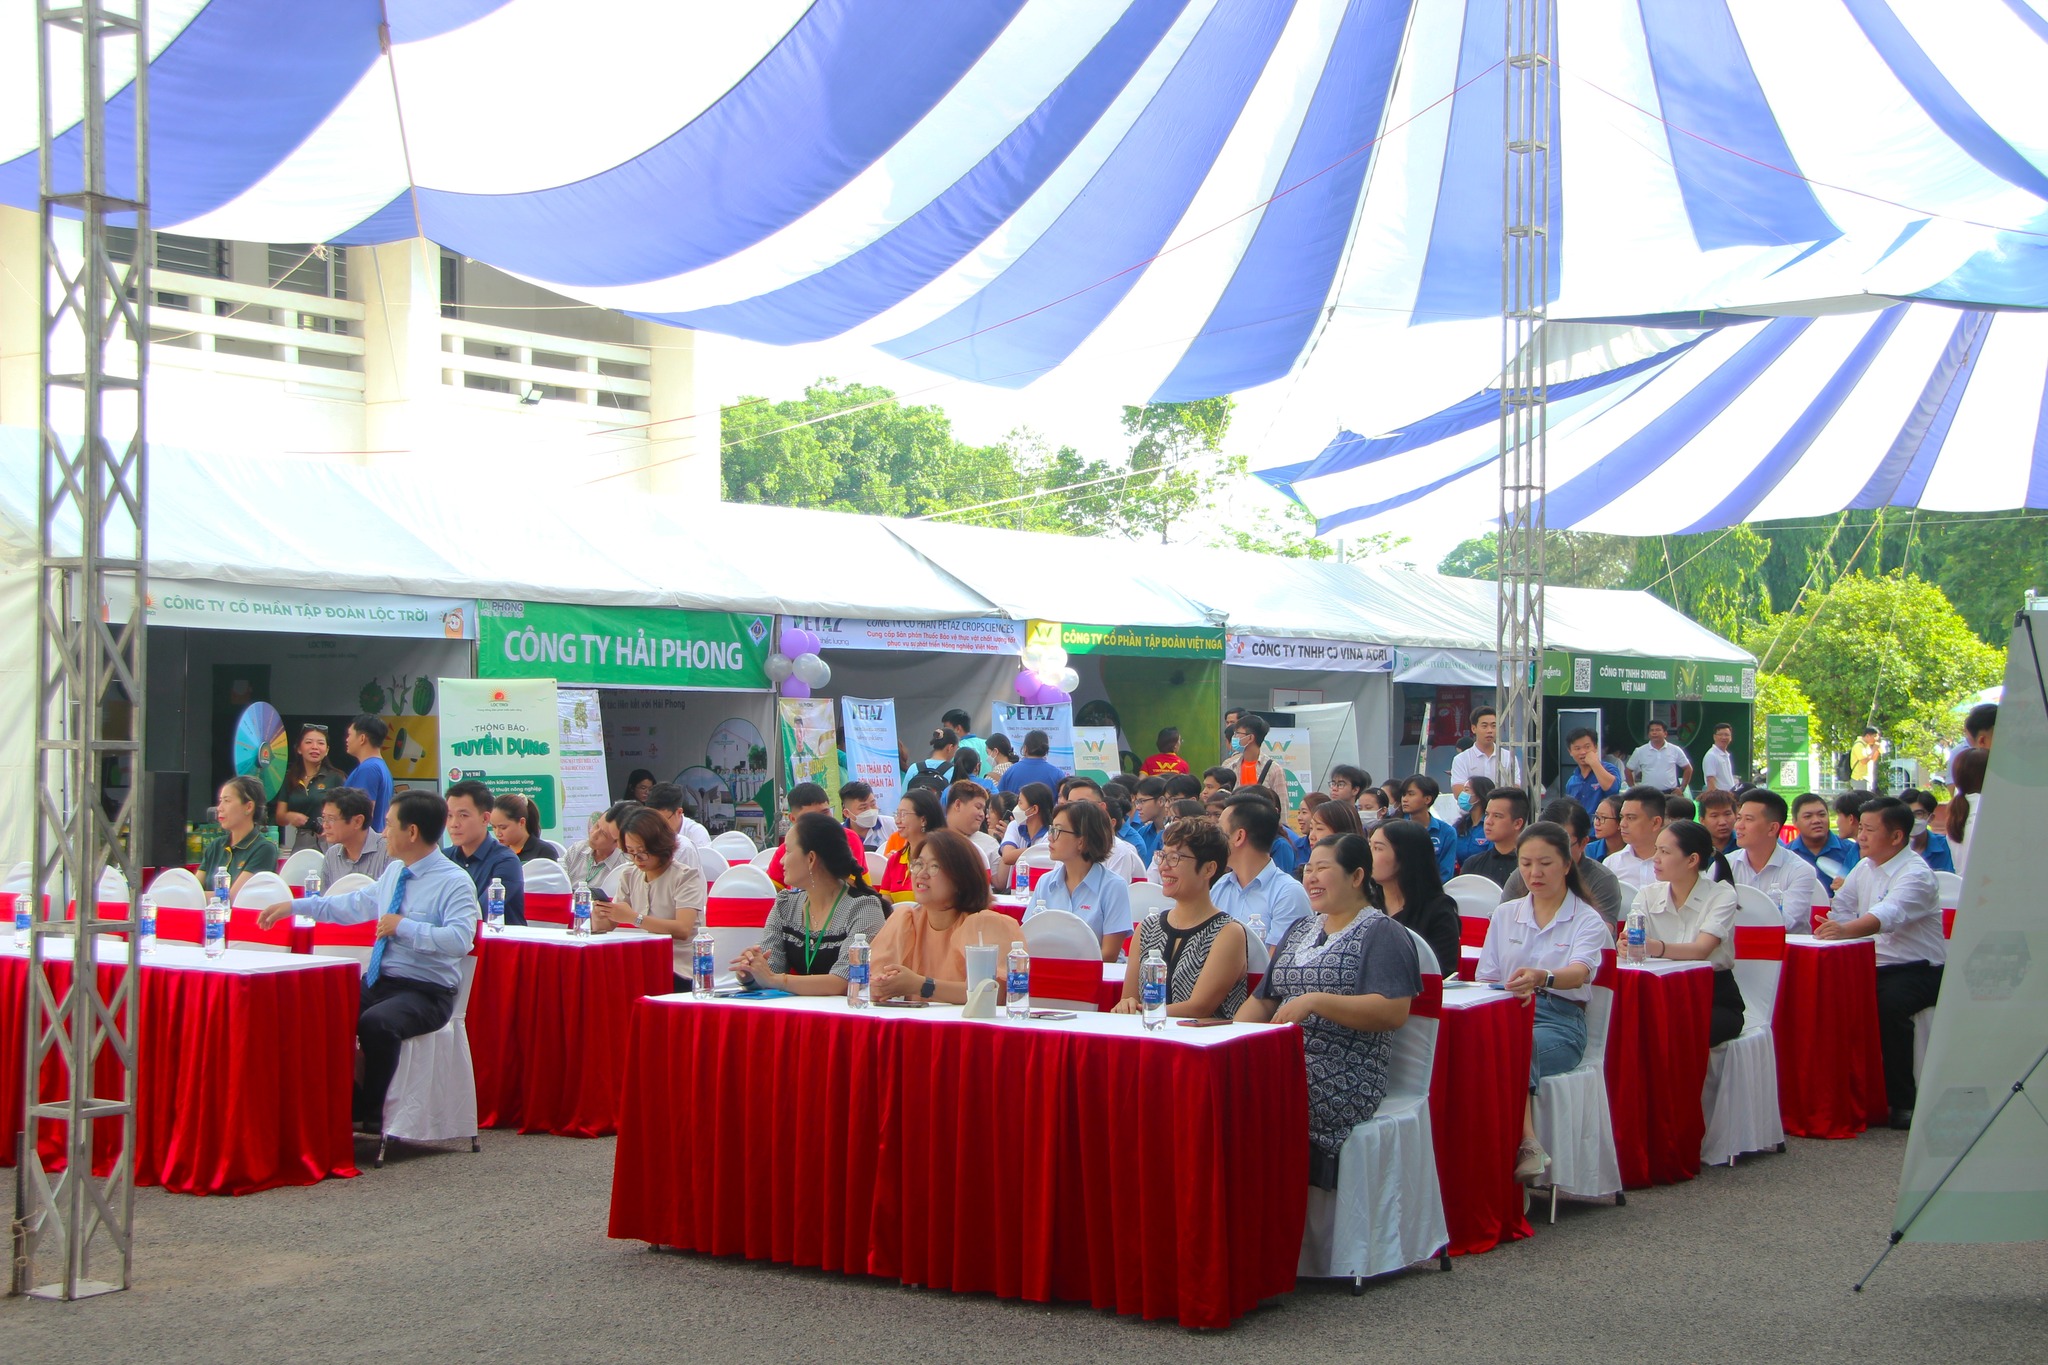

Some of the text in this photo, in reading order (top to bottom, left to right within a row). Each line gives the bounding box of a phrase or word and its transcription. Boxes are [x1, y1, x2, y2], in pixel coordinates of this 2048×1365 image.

[164, 595, 428, 623] CÔNG TY CỔ PHẦN TẬP ĐOÀN LỘC TRỜI
[938, 620, 960, 631] PETAZ
[962, 620, 1015, 634] CROPSCIENCES
[504, 624, 743, 670] CÔNG TY HẢI PHONG
[1063, 628, 1223, 652] CÔNG TY CỔ PHẦN TẬP ĐOÀN VIỆT NGA
[1251, 640, 1388, 661] CÔNG TY TNHH CJ VINA AGRI
[1543, 666, 1562, 679] ngenta
[1600, 665, 1667, 680] CÔNG TY TNHH SYNGENTA
[1621, 680, 1646, 694] VIỆT NAM
[665, 699, 686, 711] Phong
[852, 704, 883, 720] PETAZ
[1006, 705, 1055, 721] PETAZ
[475, 723, 526, 732] THÔNG BÁO
[451, 732, 550, 758] TUYỂN DỤNG
